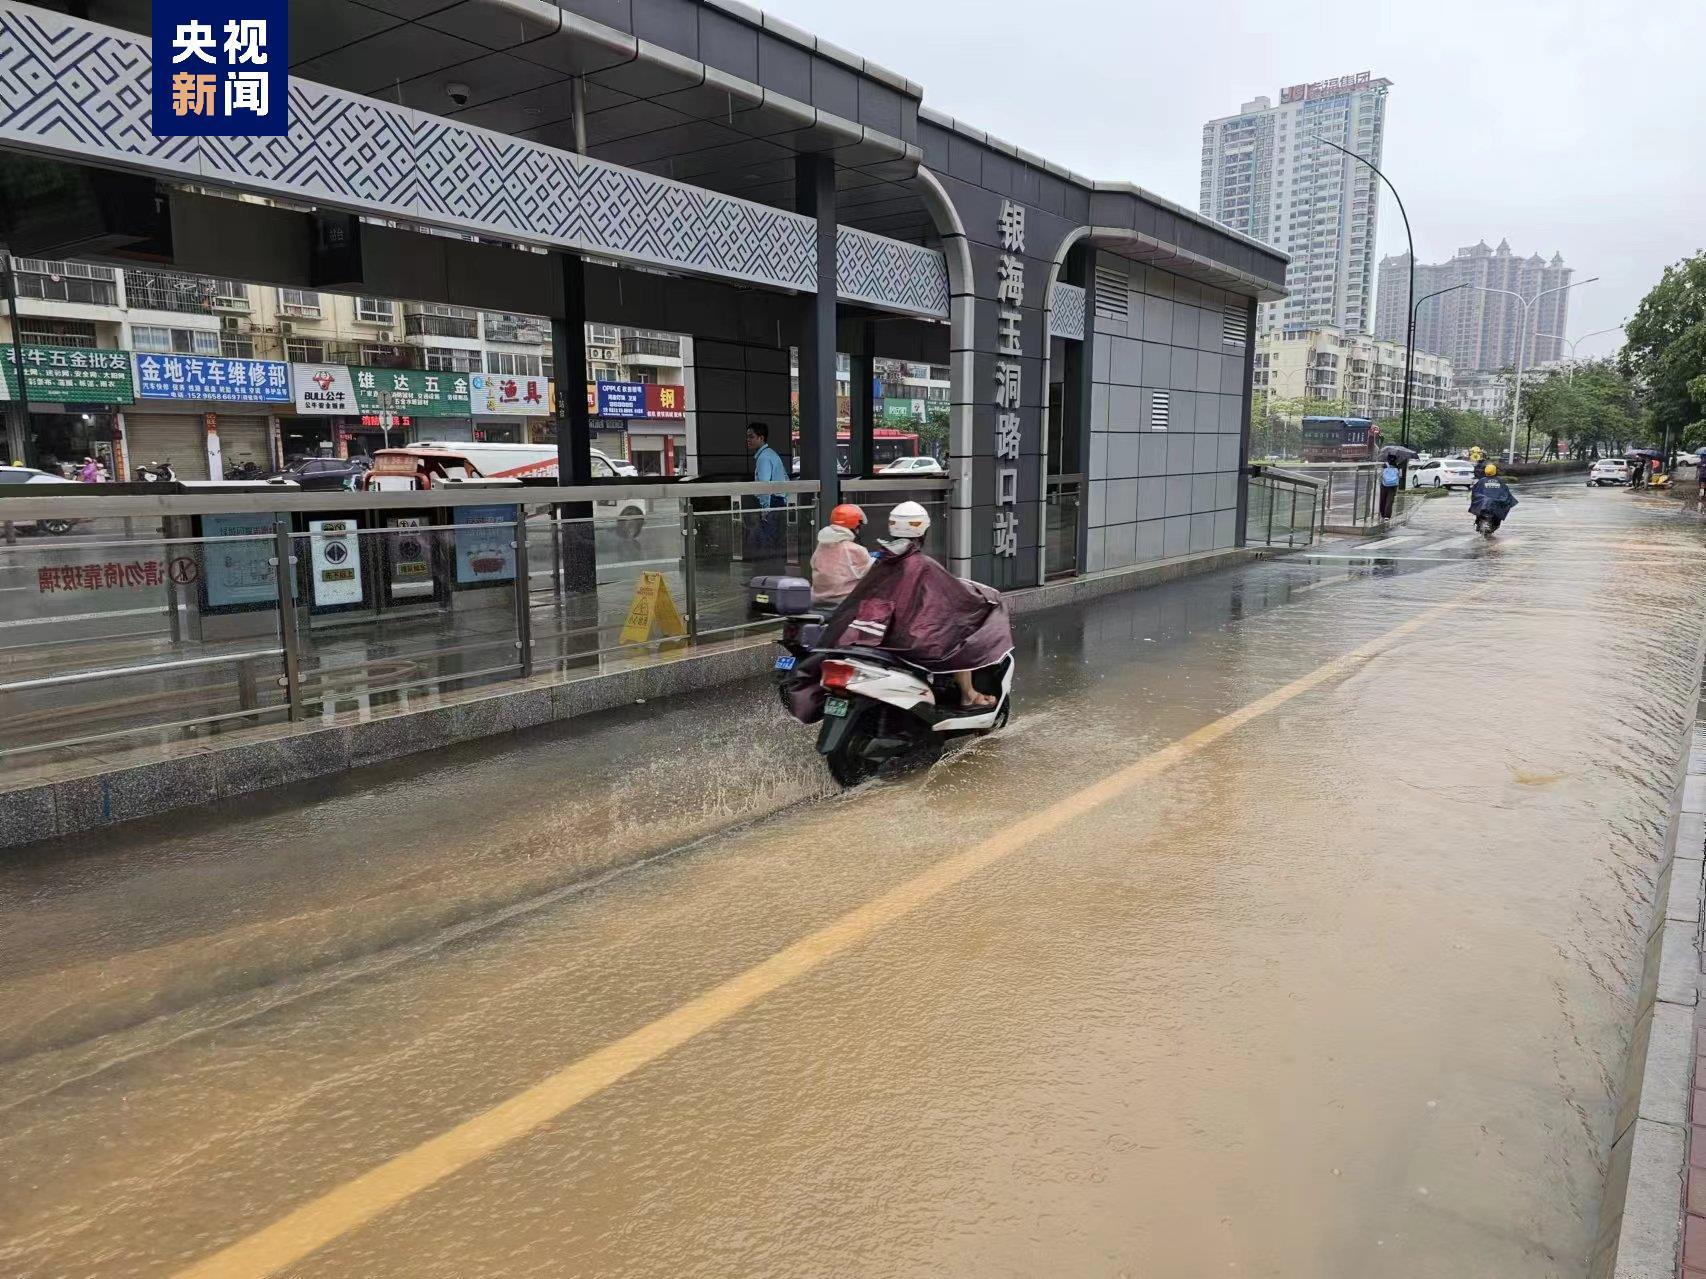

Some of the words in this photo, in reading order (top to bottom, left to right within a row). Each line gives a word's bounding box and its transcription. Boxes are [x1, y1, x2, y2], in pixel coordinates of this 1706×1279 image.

[140, 356, 286, 387] 金地汽车维修部
[358, 371, 468, 394] 雄达五金
[993, 200, 1025, 558] 银海玉洞路口站
[305, 392, 345, 401] BULL公牛
[500, 380, 542, 404] 渔具
